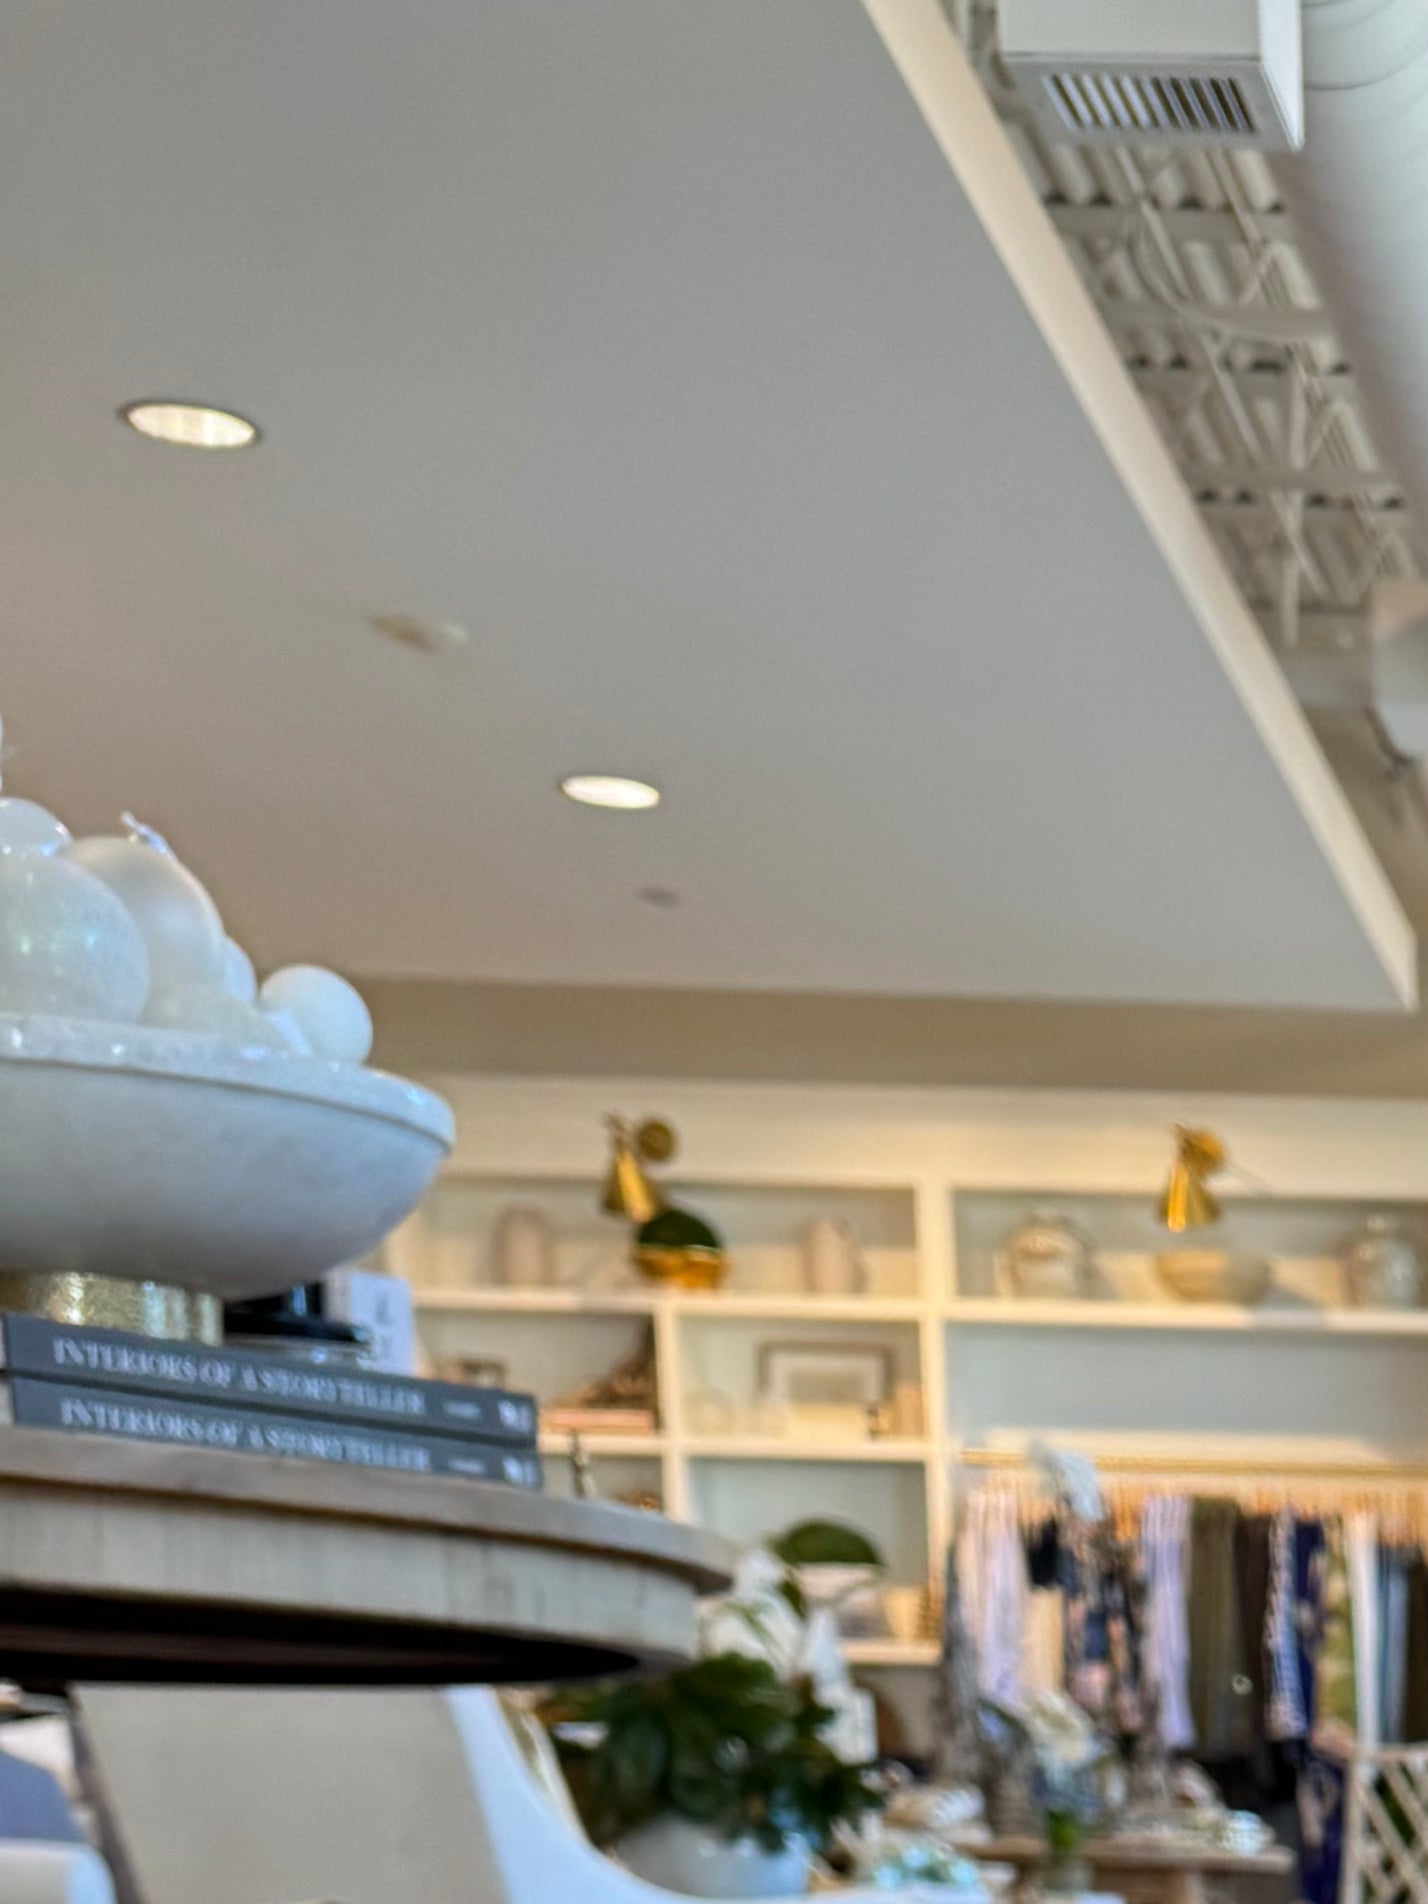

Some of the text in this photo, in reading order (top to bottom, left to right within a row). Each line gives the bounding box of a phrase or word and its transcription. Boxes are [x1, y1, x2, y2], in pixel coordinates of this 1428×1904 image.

[53, 1338, 197, 1383] INTERIORS
[199, 1361, 231, 1389] OF
[241, 1365, 258, 1391] A
[60, 1398, 204, 1441] INTERIORS
[205, 1420, 237, 1447] OF
